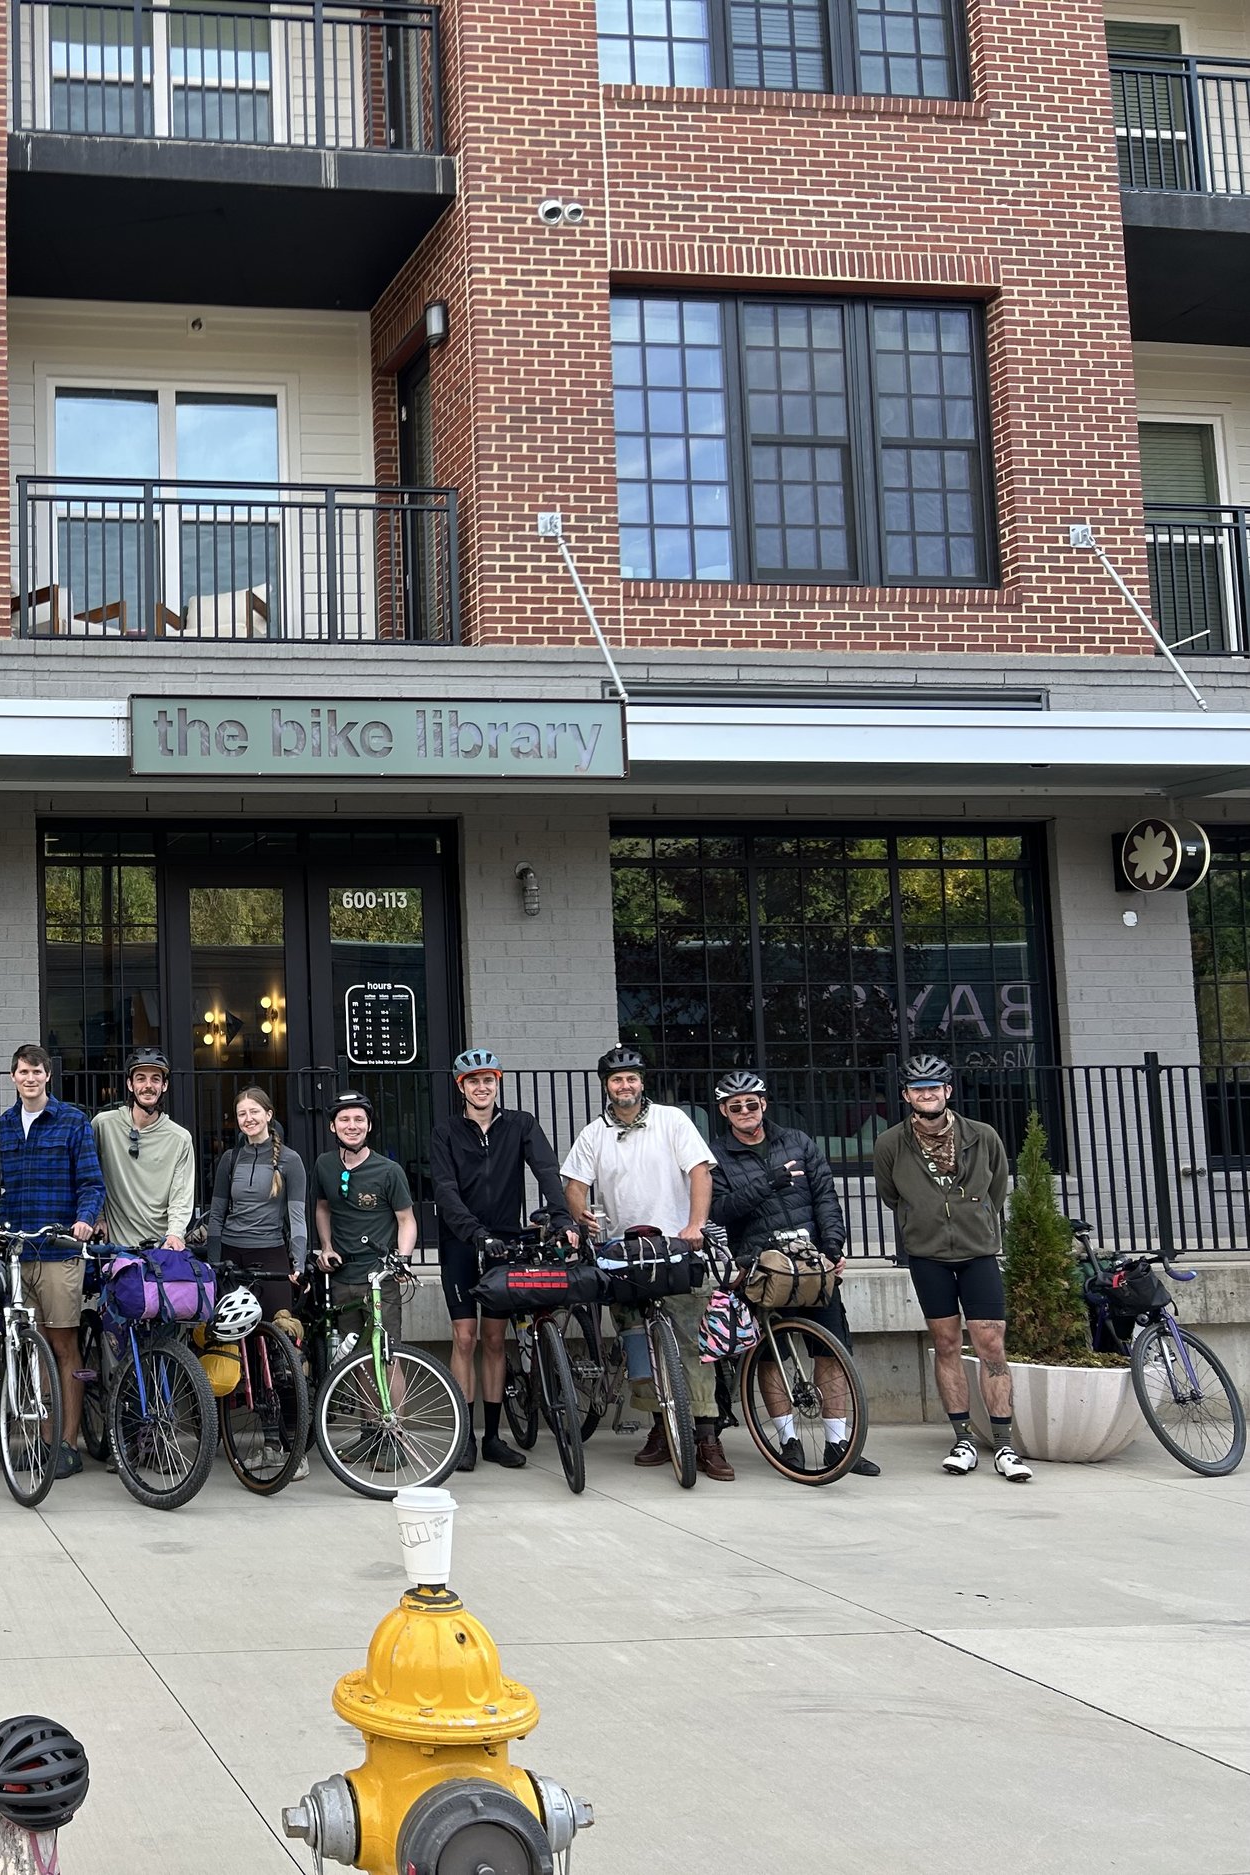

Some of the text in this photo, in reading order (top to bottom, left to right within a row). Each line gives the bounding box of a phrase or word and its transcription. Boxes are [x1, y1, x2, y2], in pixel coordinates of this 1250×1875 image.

[153, 707, 602, 773] the bike library
[342, 891, 408, 909] 600-113
[367, 982, 392, 990] hours
